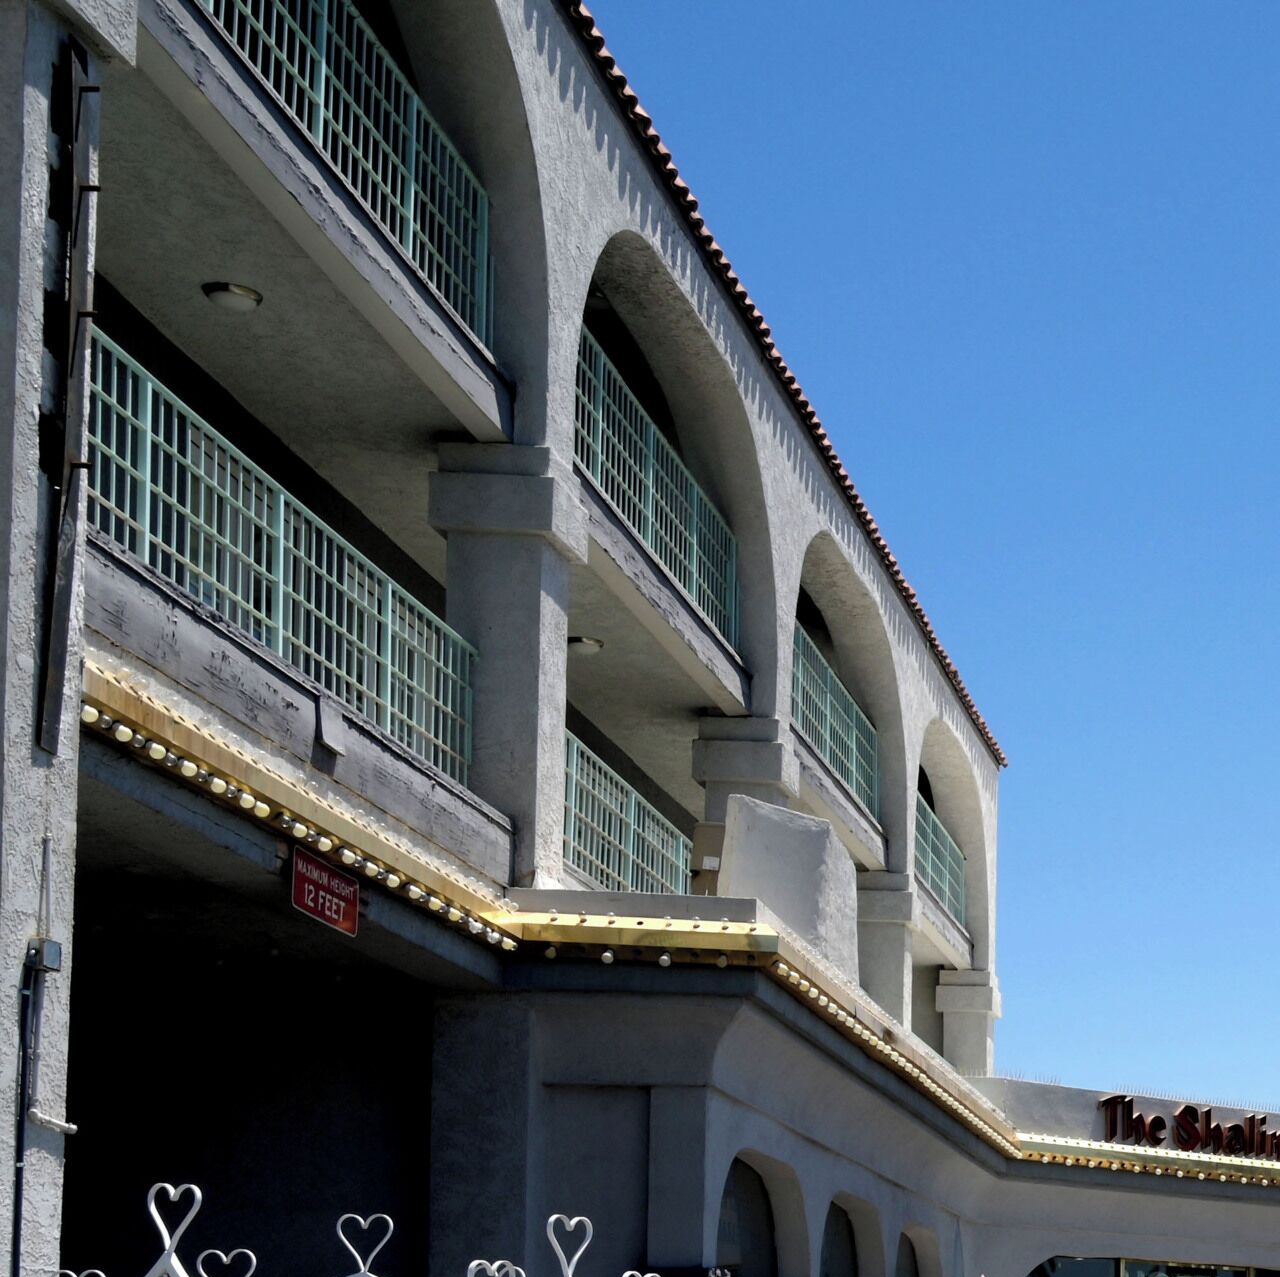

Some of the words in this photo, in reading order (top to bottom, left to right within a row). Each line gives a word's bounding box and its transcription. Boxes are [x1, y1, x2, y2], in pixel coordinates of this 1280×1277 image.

[296, 858, 329, 888] MAXIMUM
[329, 876, 354, 901] HEIGHT
[304, 882, 315, 908] 12
[318, 890, 346, 922] FEET
[1099, 1095, 1167, 1145] The
